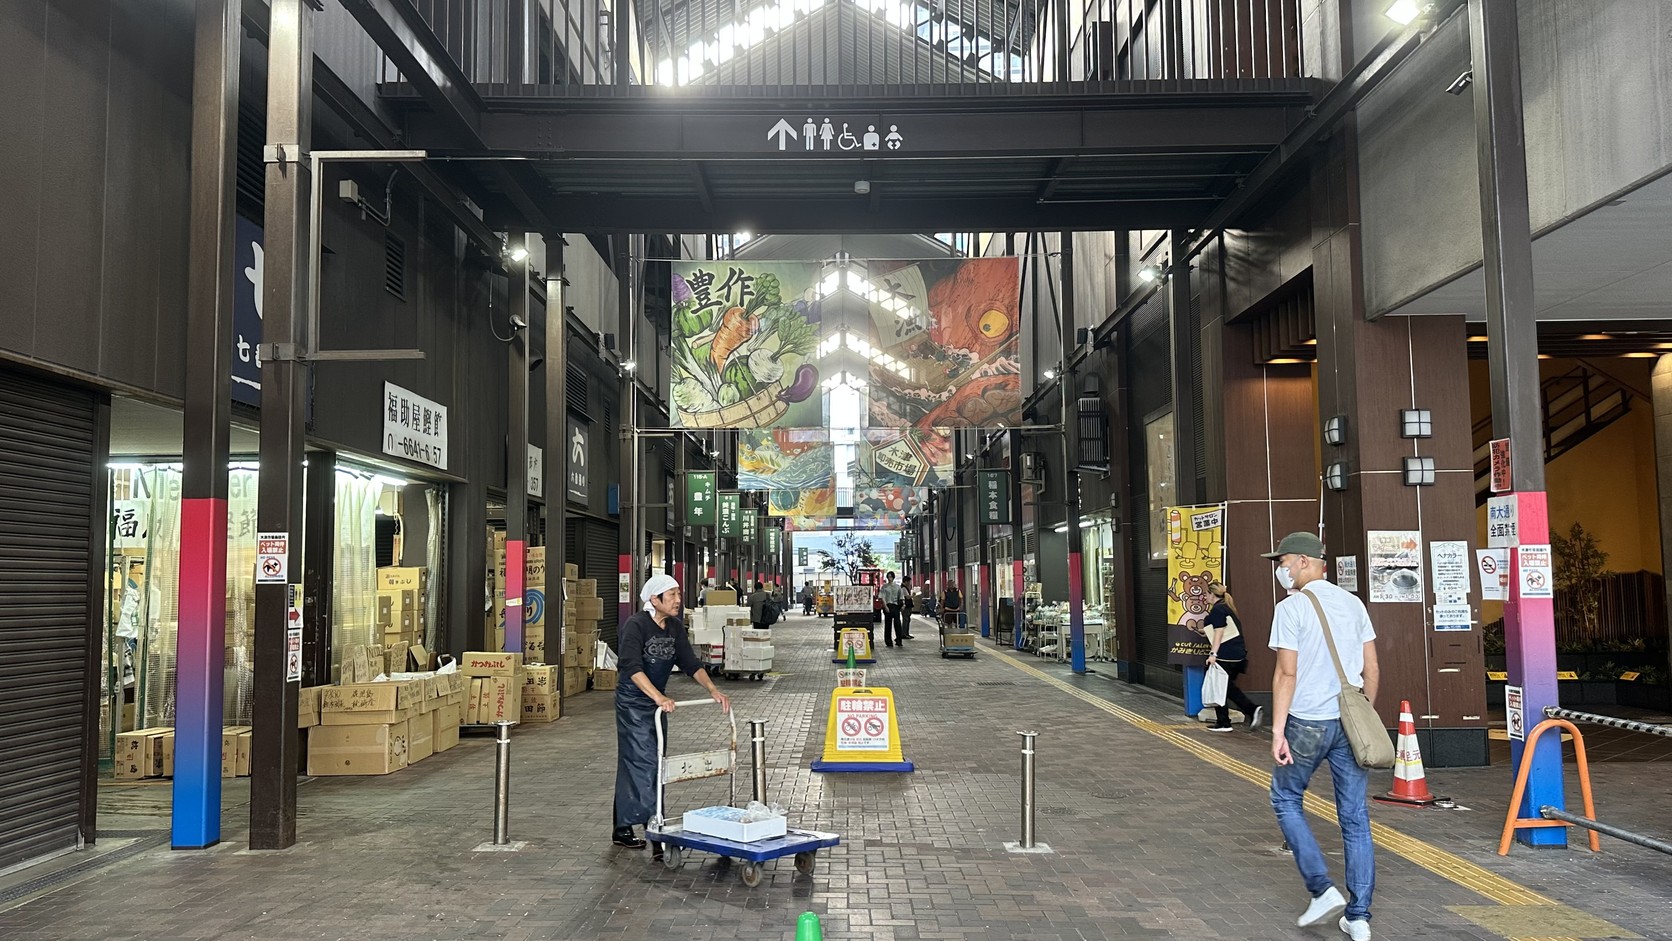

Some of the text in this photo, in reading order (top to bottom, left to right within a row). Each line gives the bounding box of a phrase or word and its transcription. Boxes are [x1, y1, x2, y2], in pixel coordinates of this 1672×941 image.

[685, 267, 755, 315] 豊作
[388, 392, 442, 437] 福助屋鰹節
[889, 446, 913, 461] 木津
[877, 452, 917, 475] 卸売市場
[693, 491, 703, 516] 豊年
[1193, 513, 1218, 522] カットサロン
[1490, 505, 1515, 521] 南大通り
[1194, 517, 1219, 529] 営業中
[471, 660, 505, 669] かつおぶし
[840, 700, 885, 711] 駐輪禁止
